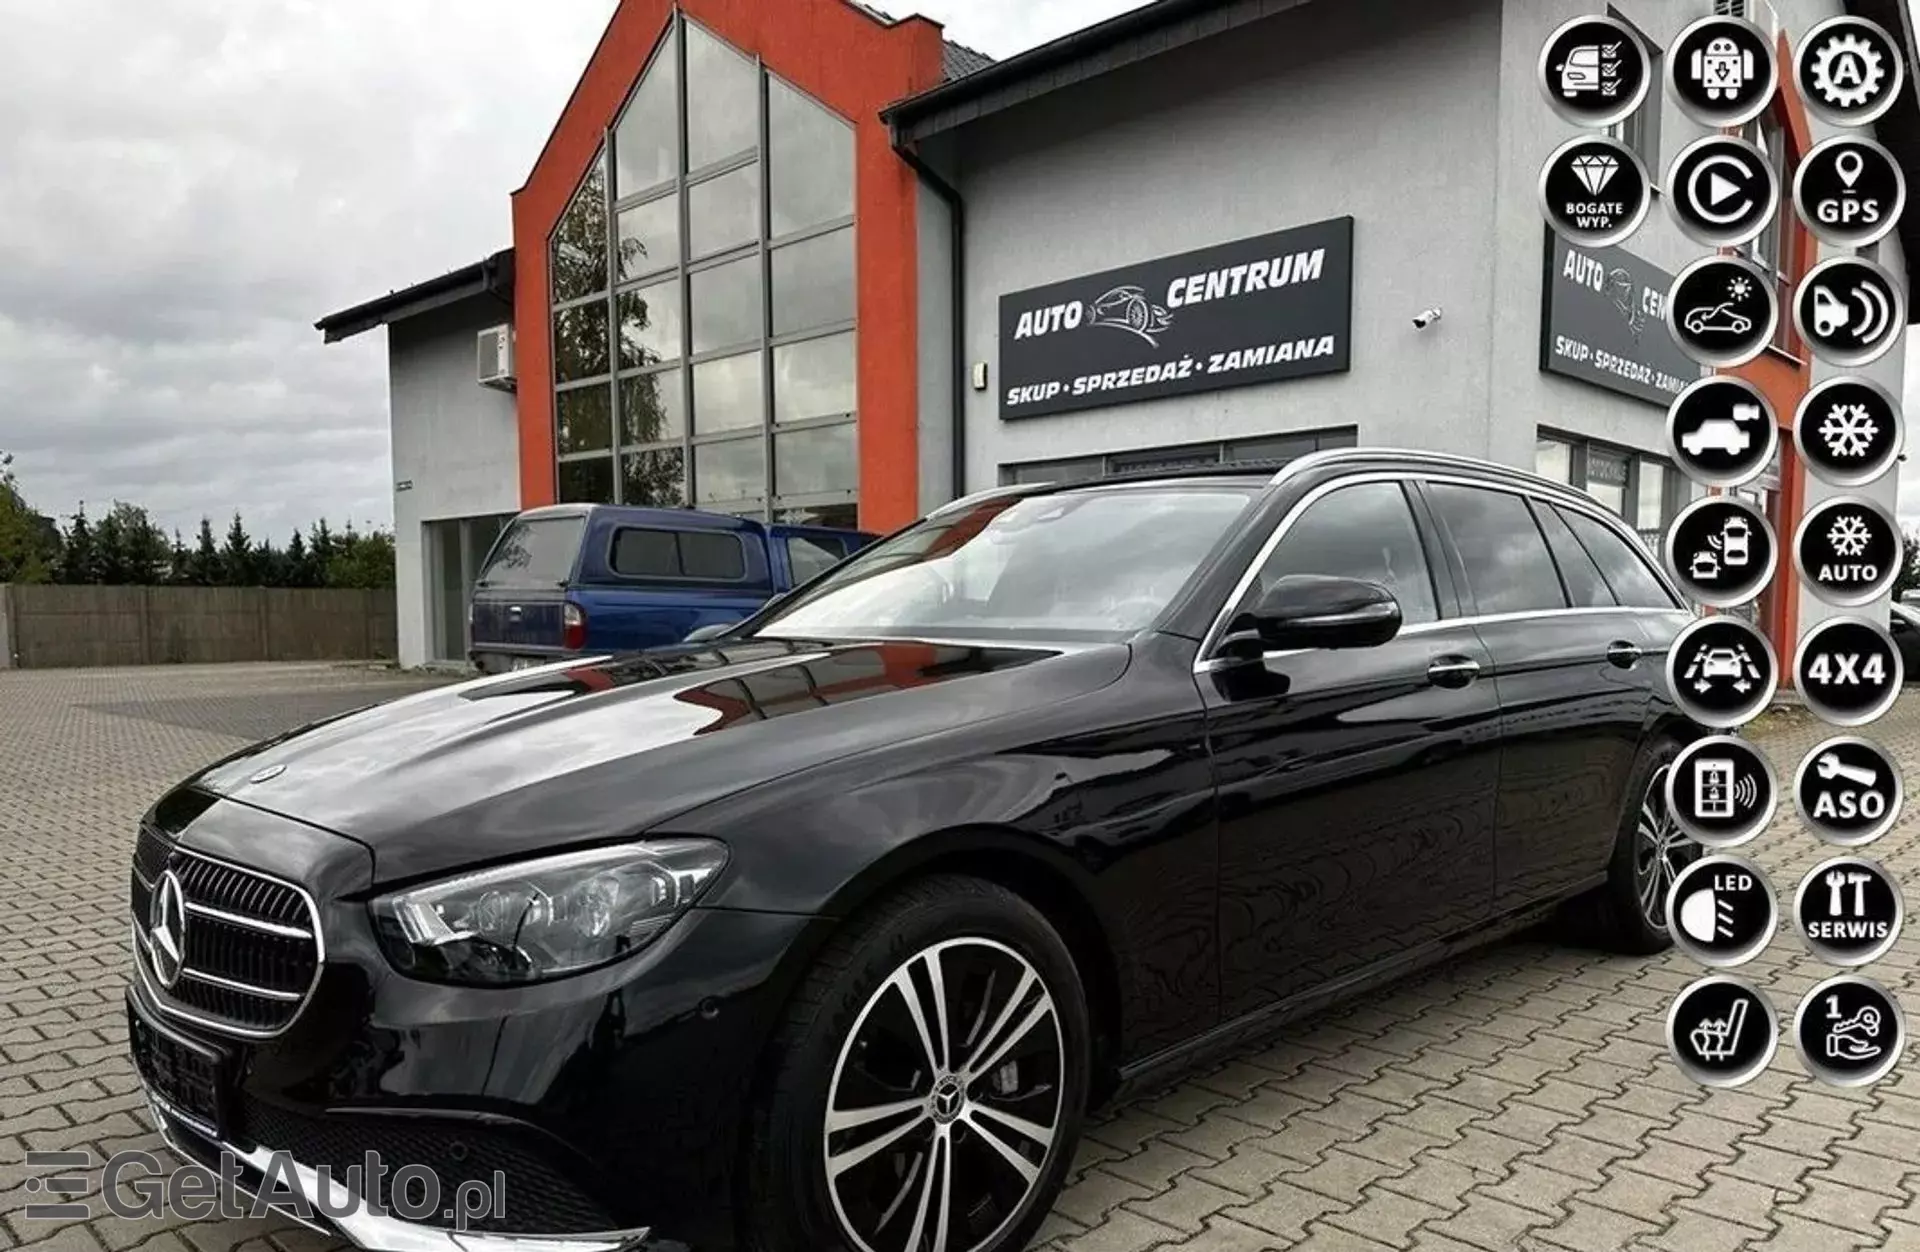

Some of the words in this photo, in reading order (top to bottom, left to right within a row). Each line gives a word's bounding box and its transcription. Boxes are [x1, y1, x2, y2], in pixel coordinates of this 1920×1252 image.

[1014, 300, 1083, 340] AUTO
[1167, 248, 1326, 309] CENTRUM
[1563, 249, 1604, 292] AUTO
[1642, 286, 1667, 320] CEN
[1006, 381, 1061, 406] SKUP
[1072, 354, 1194, 396] SPRZEDAŻ
[1207, 334, 1335, 374] ZAMIANA
[1555, 335, 1589, 362] SKUP
